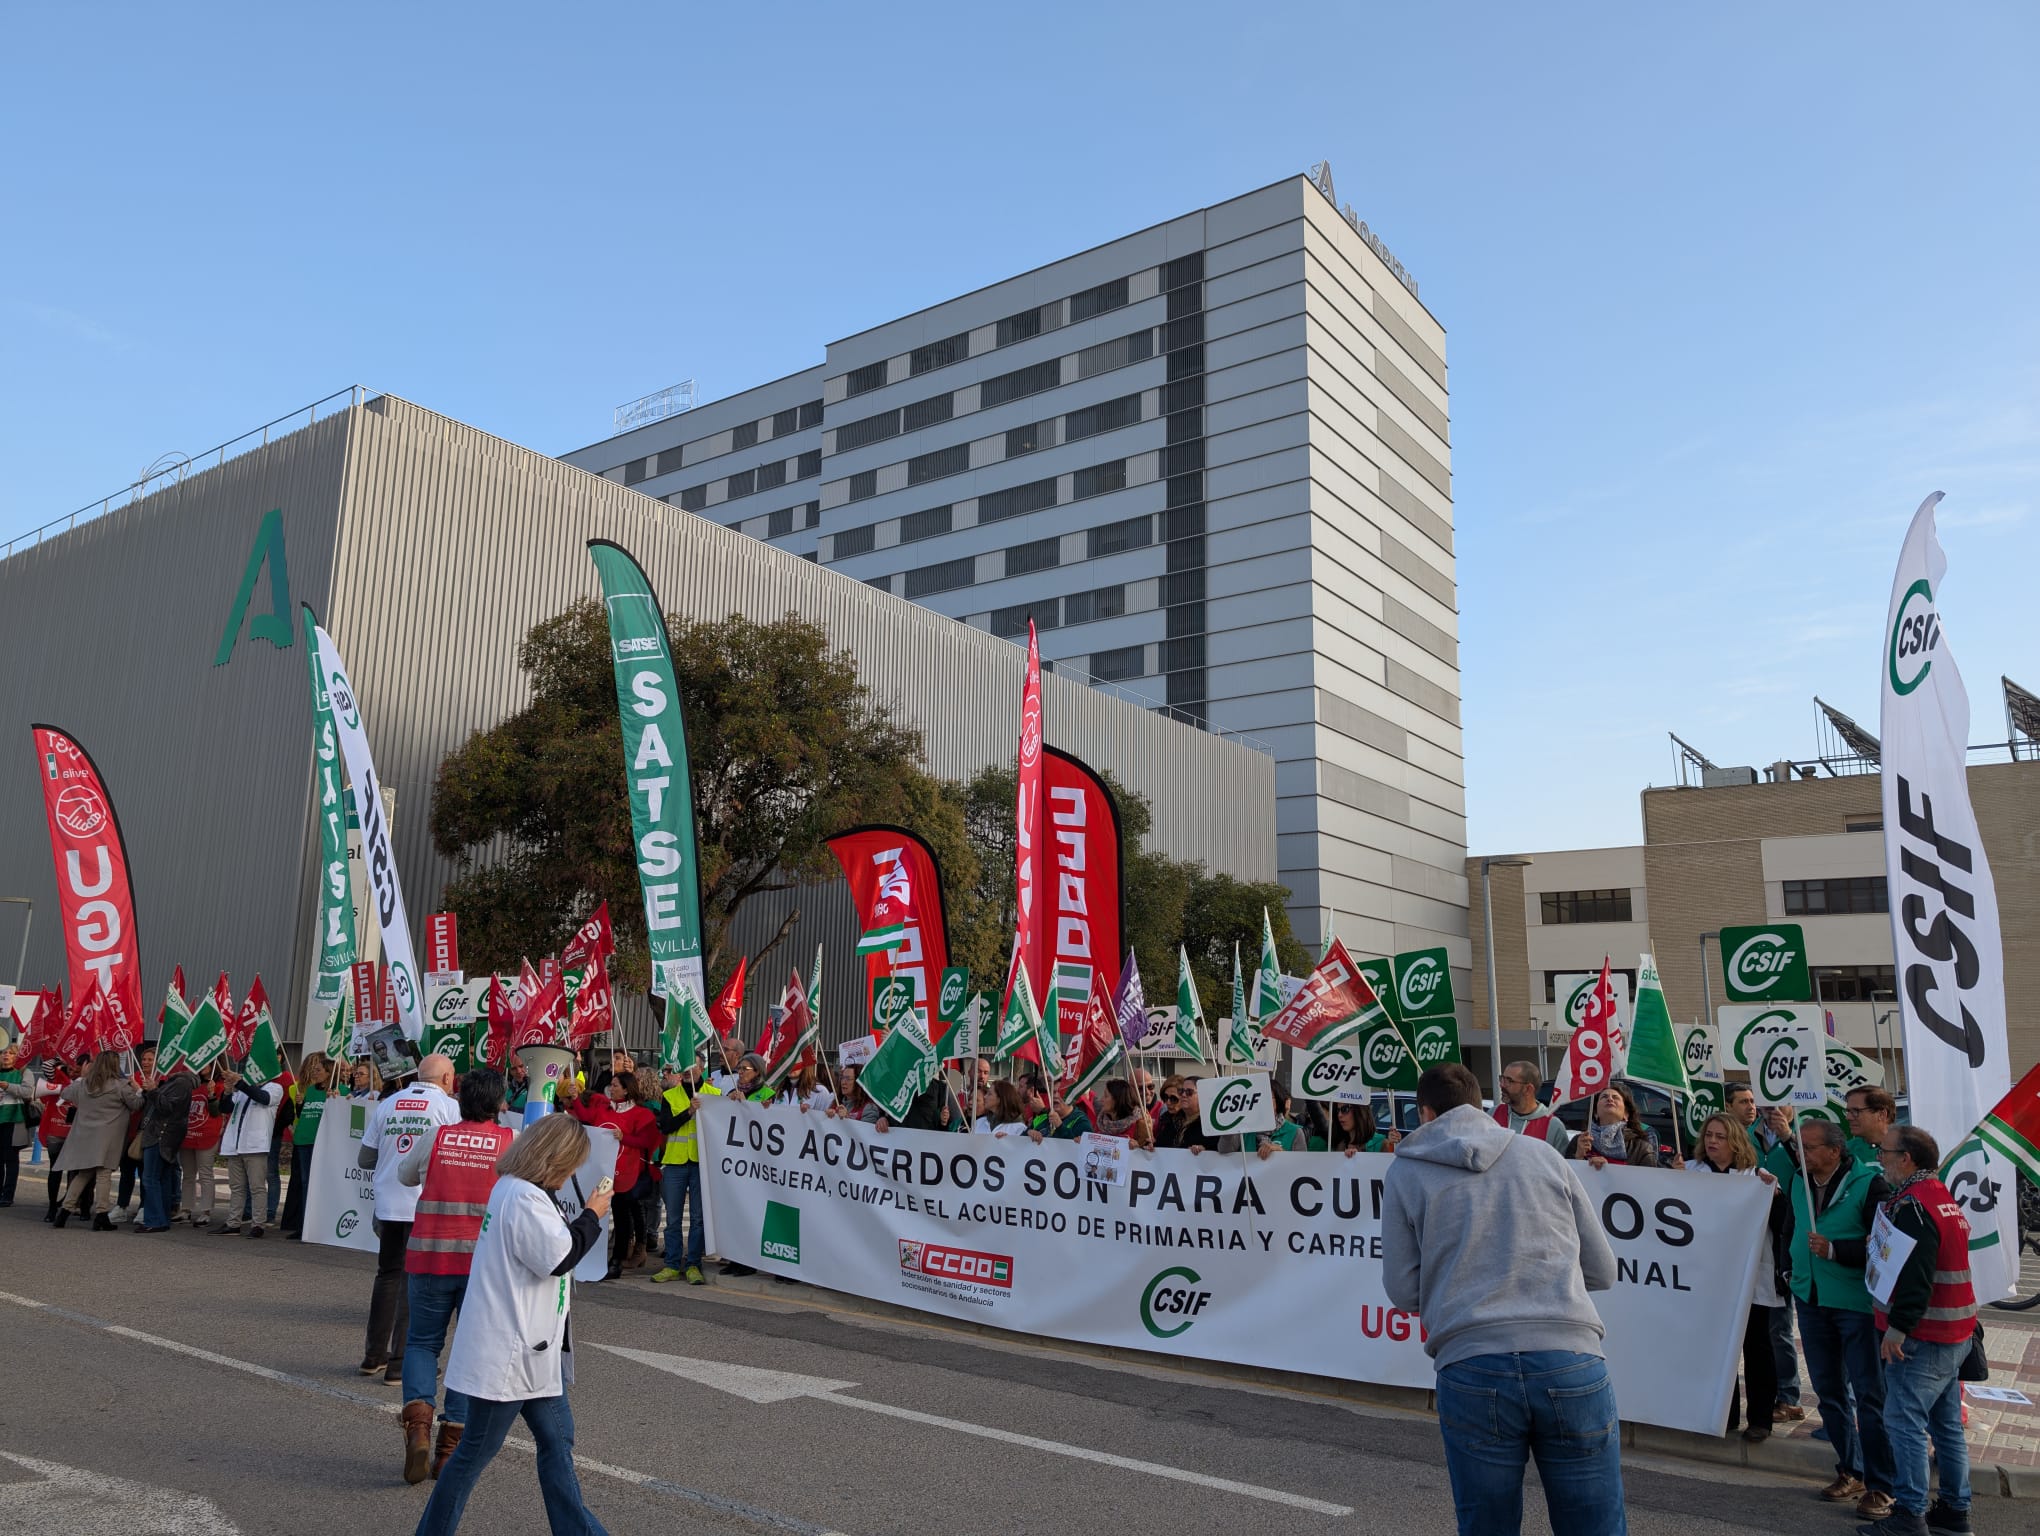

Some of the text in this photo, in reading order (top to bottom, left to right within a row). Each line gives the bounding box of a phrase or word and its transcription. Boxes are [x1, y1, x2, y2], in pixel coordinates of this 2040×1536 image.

[619, 637, 658, 653] SATSE
[631, 670, 683, 931] SATSE
[1897, 772, 1986, 1069] CSIF
[435, 916, 450, 973] CCOO
[1741, 952, 1796, 973] CSIF
[1408, 971, 1444, 993] CSIF
[882, 995, 909, 1010] CSIF
[944, 987, 963, 1002] CSIF
[1371, 1045, 1407, 1064] CSIF
[1418, 1041, 1452, 1061] CSIF
[1340, 1092, 1363, 1101] SEVILLA
[1794, 1092, 1818, 1100] SEVILLA
[399, 1117, 432, 1127] JUNTA
[443, 1133, 497, 1150] CCOO
[437, 1150, 463, 1158] sanidad
[469, 1154, 497, 1162] sectores
[440, 1159, 490, 1169] sociosanitarios
[345, 1168, 362, 1180] LOS
[726, 1116, 786, 1156] LOS
[798, 1129, 1005, 1193] ACUERDOS
[1129, 1170, 1266, 1216] PARA
[359, 1187, 375, 1200] LOS
[722, 1157, 832, 1197] CONSEJERA,
[838, 1180, 919, 1212] CUMPLE
[926, 1199, 949, 1219] EL
[958, 1202, 1067, 1233] ACUERDO
[1077, 1216, 1106, 1239] DE
[1115, 1221, 1247, 1252] PRIMARIA
[1257, 1230, 1275, 1252] Y
[1287, 1231, 1383, 1260] CARRE
[340, 1217, 359, 1230] CSIF
[763, 1240, 799, 1260] SATSE
[926, 1250, 992, 1279] CCOO
[901, 1269, 933, 1285] federación
[934, 1277, 942, 1286] de
[943, 1280, 973, 1292] sanidad
[980, 1286, 1011, 1299] sectores
[902, 1280, 994, 1307] sociosanitarios de Andalucía
[1153, 1288, 1212, 1317] CSIF
